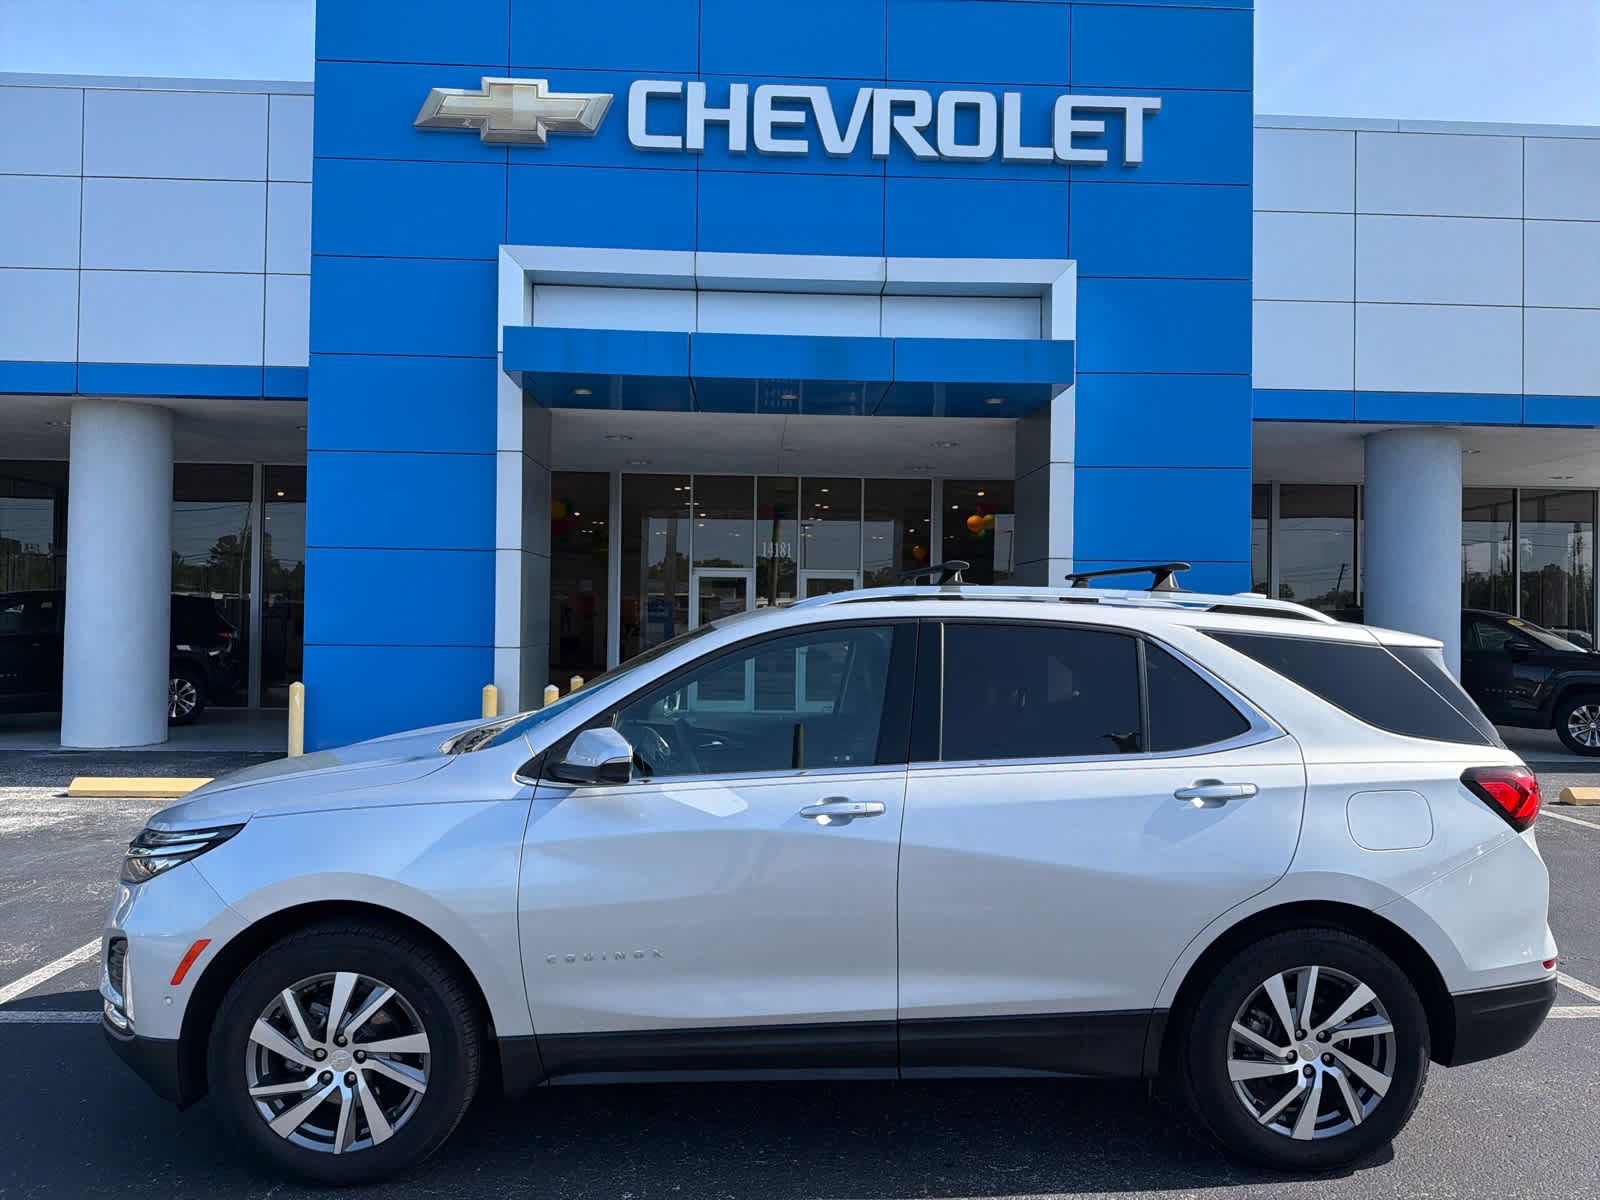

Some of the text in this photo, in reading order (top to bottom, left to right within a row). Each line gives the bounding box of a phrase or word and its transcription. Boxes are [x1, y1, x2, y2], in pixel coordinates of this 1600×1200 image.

[628, 79, 1162, 168] CHEVROLET
[762, 542, 792, 558] 14181
[545, 949, 664, 963] EQUINOX
